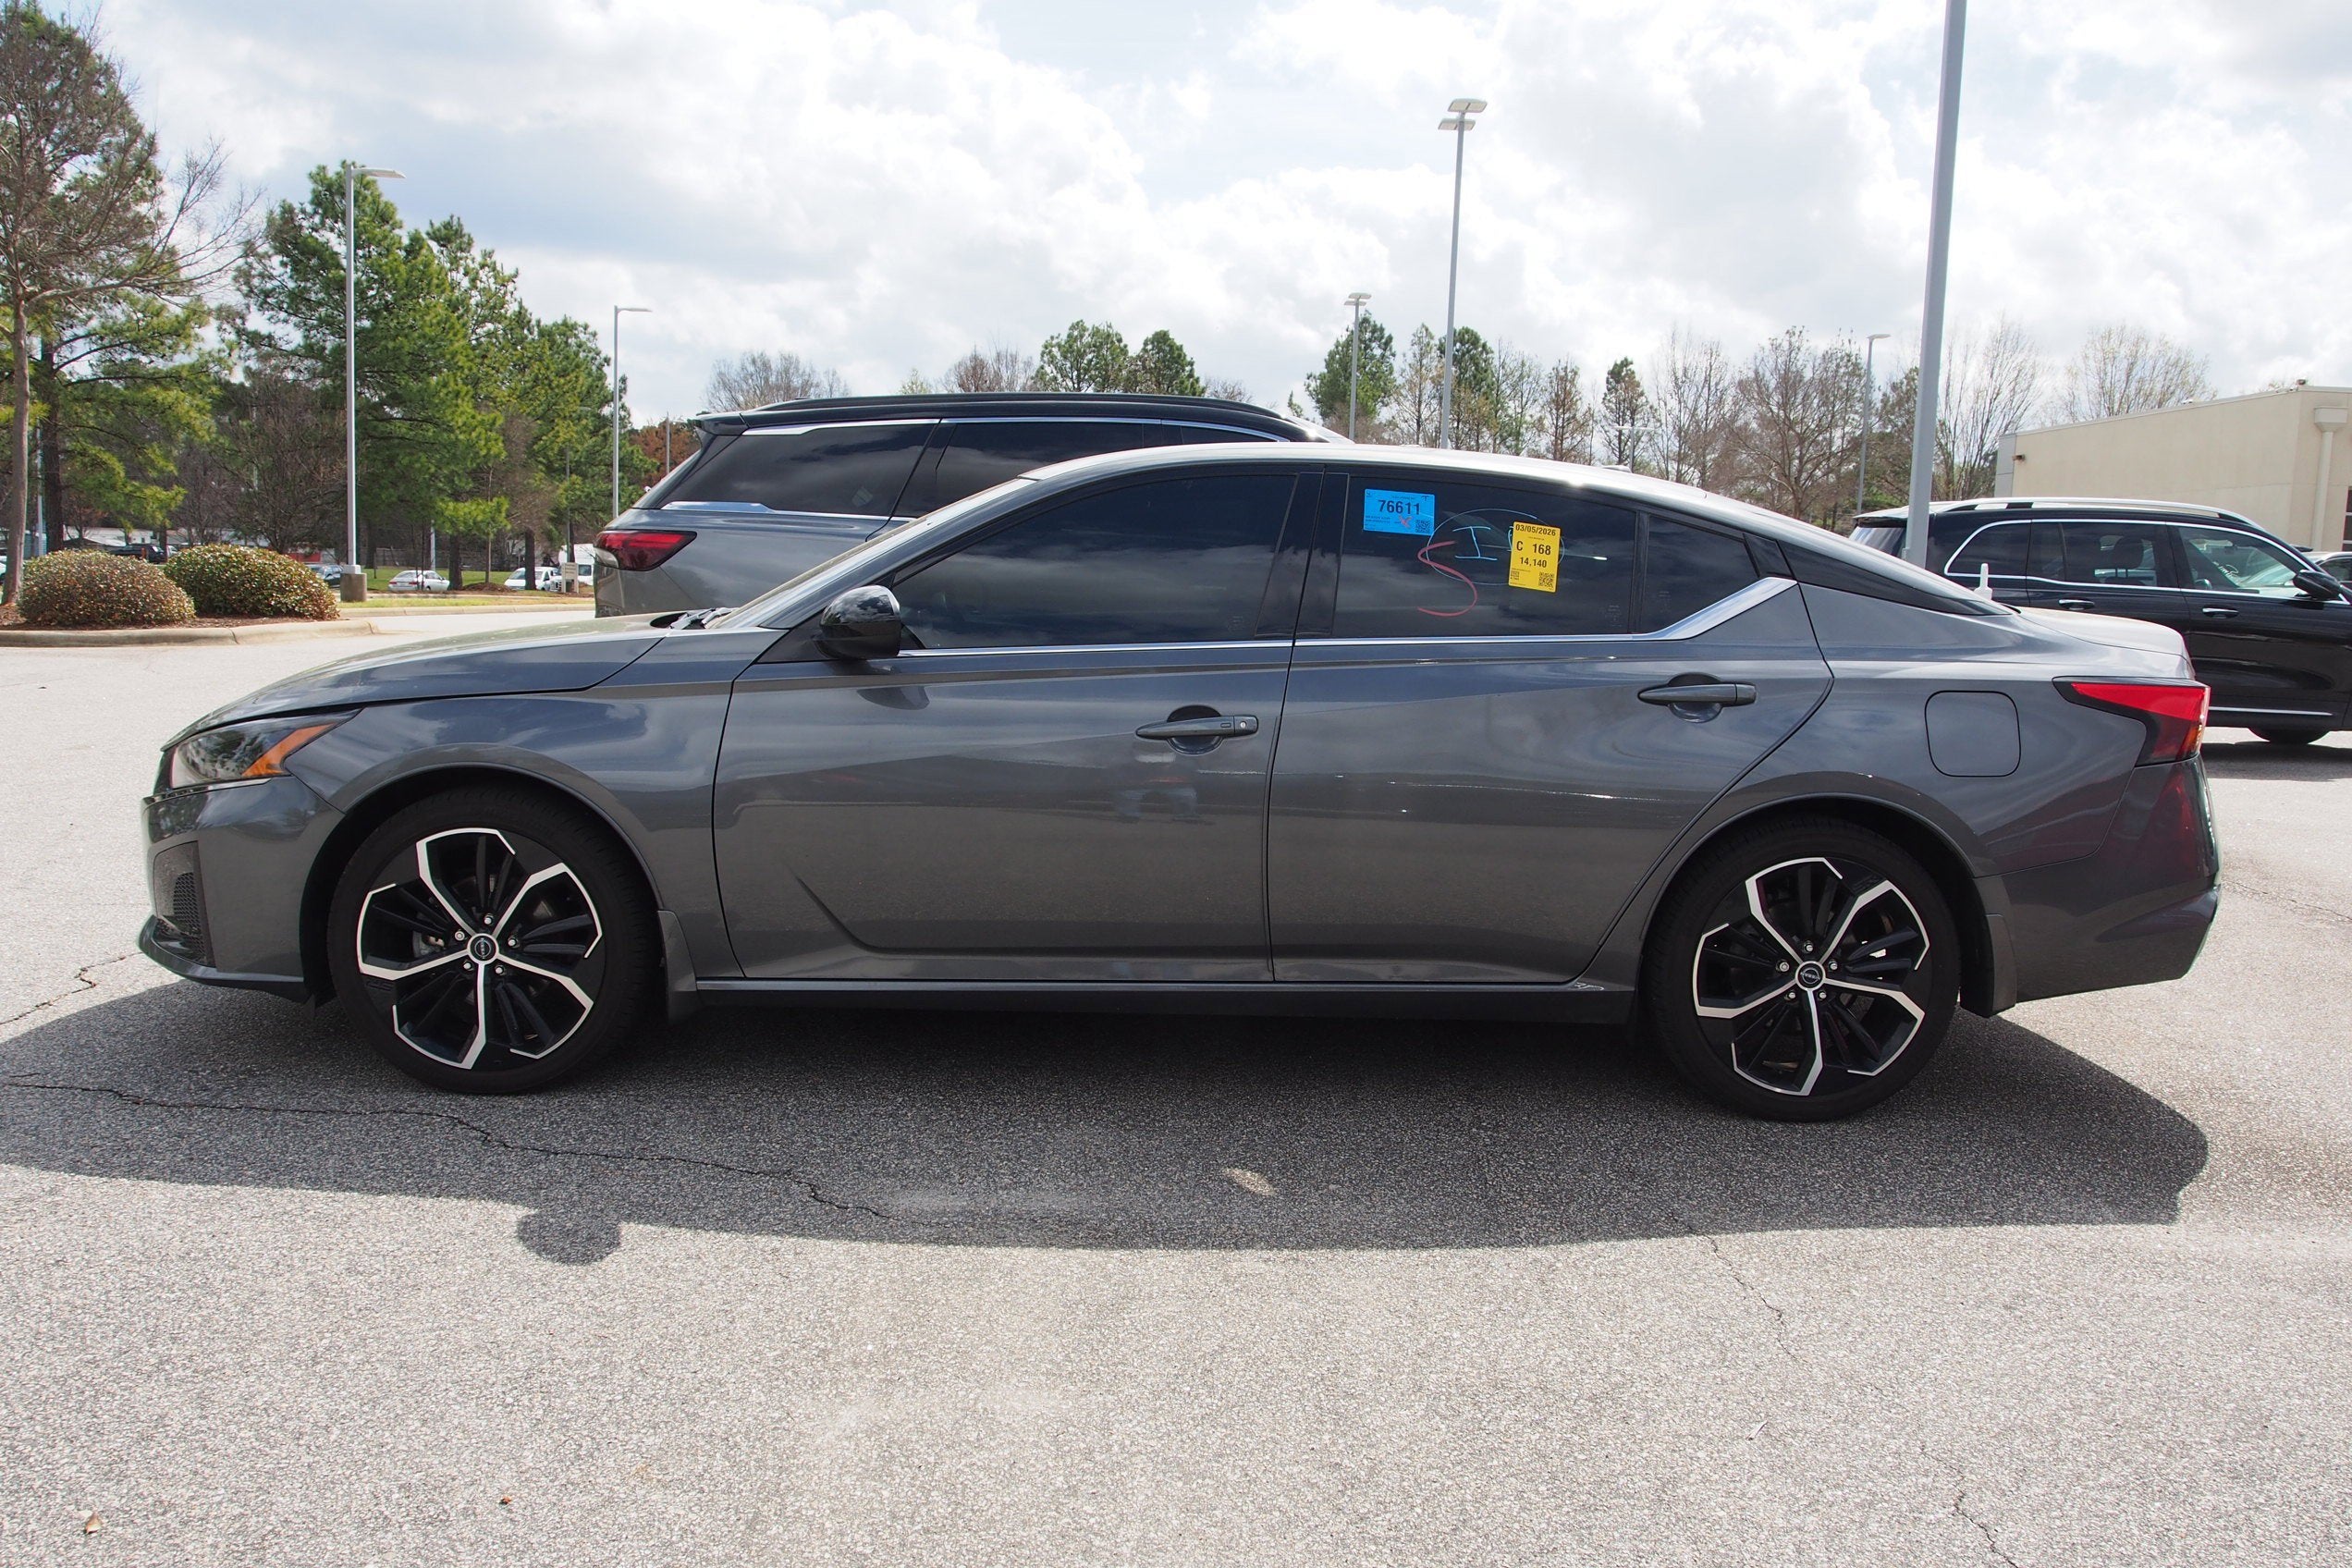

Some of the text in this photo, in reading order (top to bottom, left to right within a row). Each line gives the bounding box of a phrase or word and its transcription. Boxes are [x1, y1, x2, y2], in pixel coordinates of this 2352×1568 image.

[1378, 499, 1420, 515] 76611
[1515, 523, 1556, 536] 03/05/2026
[1516, 540, 1551, 556] C 168
